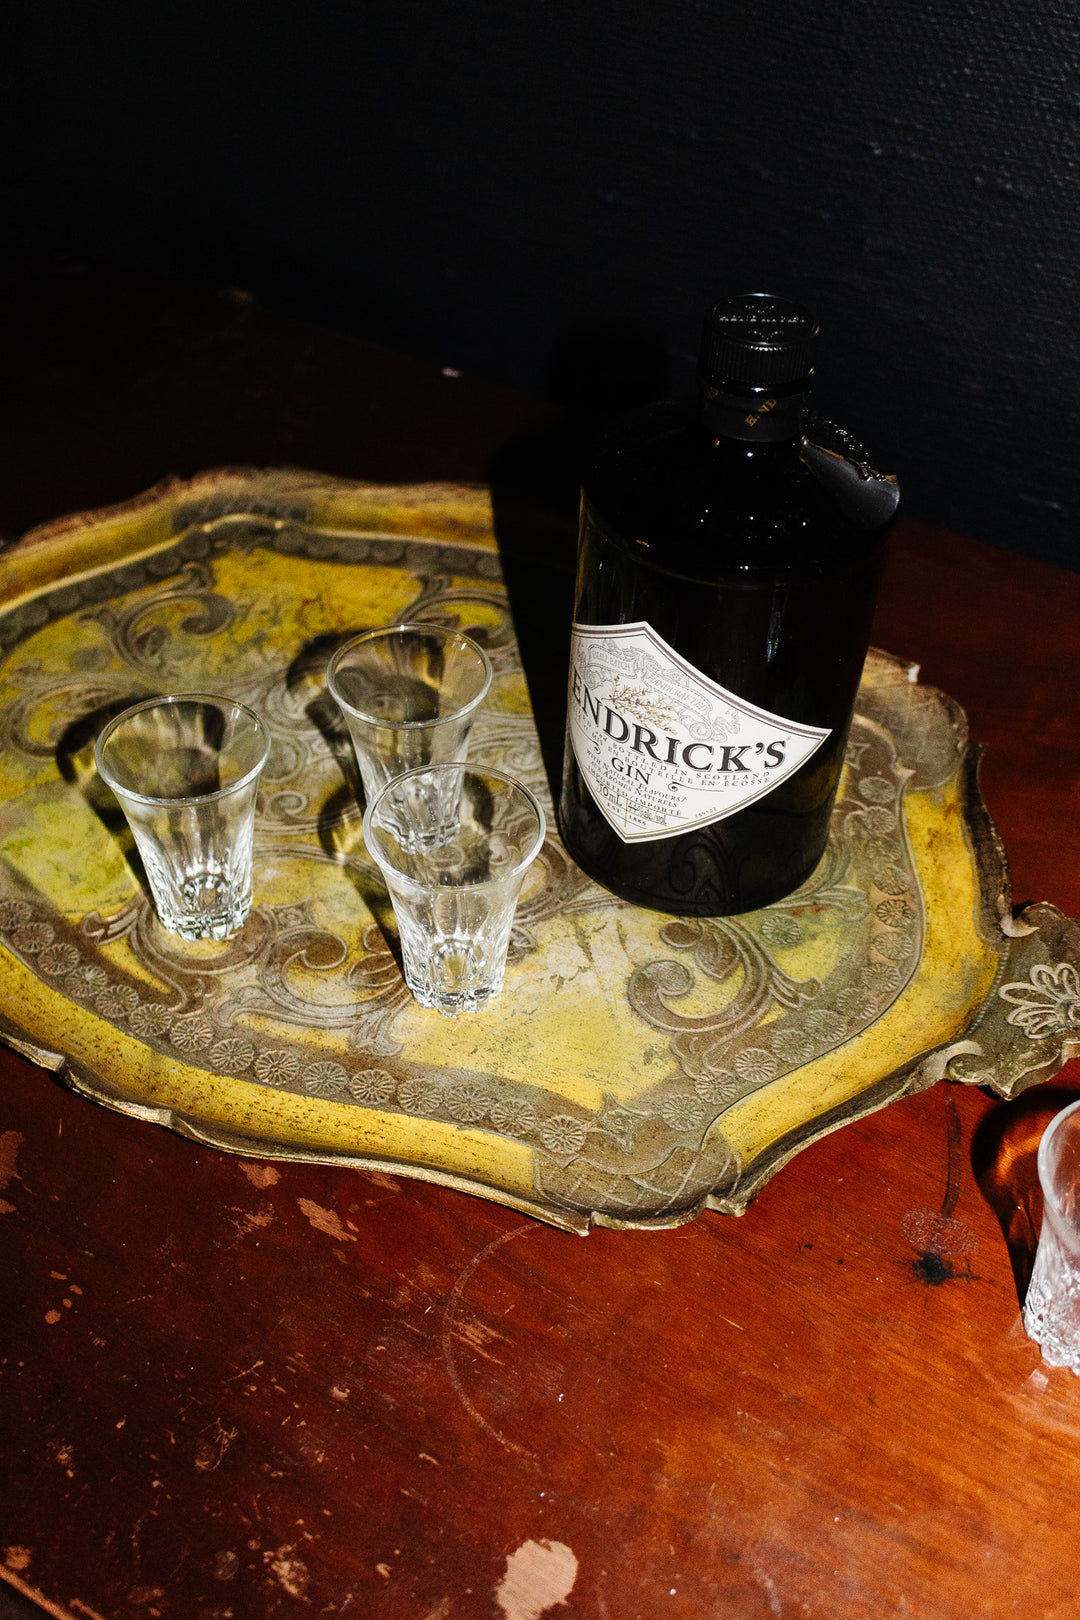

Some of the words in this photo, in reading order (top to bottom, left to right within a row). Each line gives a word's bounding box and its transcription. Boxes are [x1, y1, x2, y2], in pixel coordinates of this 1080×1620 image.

[647, 674, 708, 711] HANDCRAFTED
[572, 665, 786, 773] ENDRICK'S
[603, 763, 637, 788] NATURAL
[611, 757, 652, 785] GIN
[613, 743, 666, 771] BOTTLED
[674, 768, 688, 776] IN
[696, 771, 770, 780] SCOTLAND
[624, 756, 693, 784] BOUTEILLE
[724, 777, 770, 787] ÉCOSSE
[635, 787, 677, 808] NATURELS
